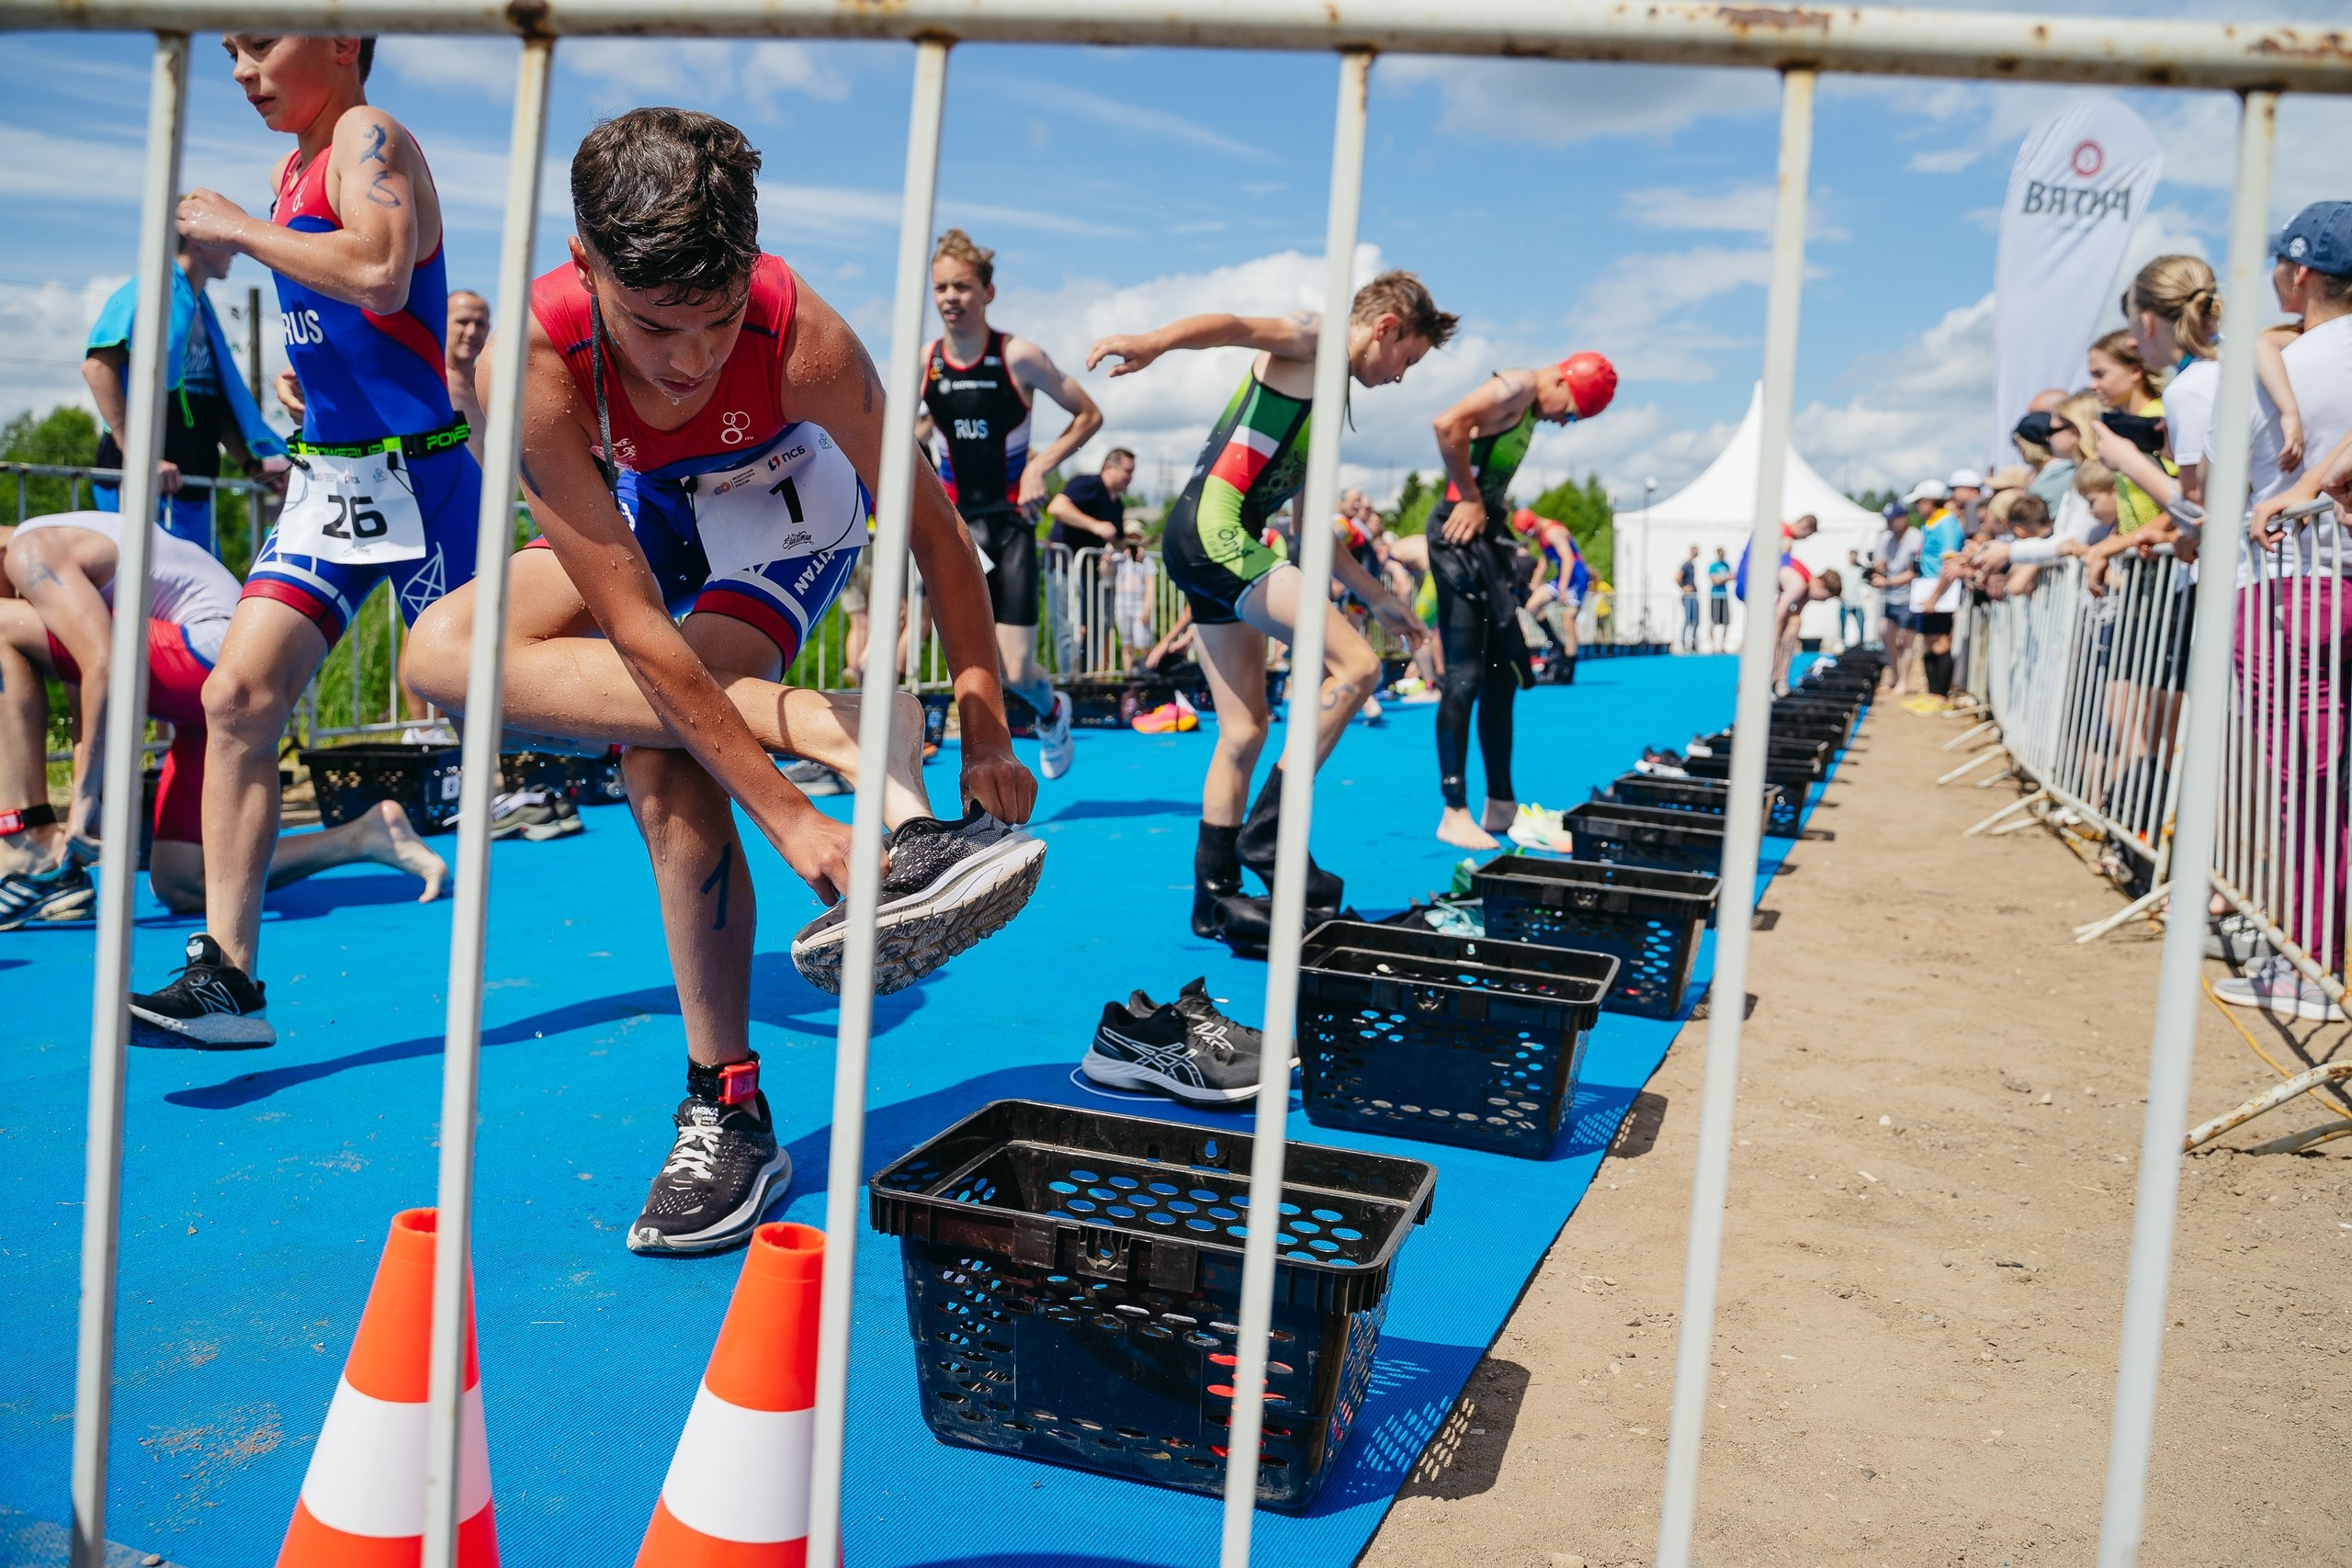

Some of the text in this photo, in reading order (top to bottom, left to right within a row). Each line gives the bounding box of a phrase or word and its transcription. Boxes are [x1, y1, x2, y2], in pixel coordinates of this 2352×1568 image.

[281, 309, 323, 345] RUS
[954, 419, 989, 439] RUS
[781, 446, 806, 463] ПСБ
[322, 494, 388, 539] 26
[769, 475, 804, 524] 1
[701, 842, 732, 931] 1
